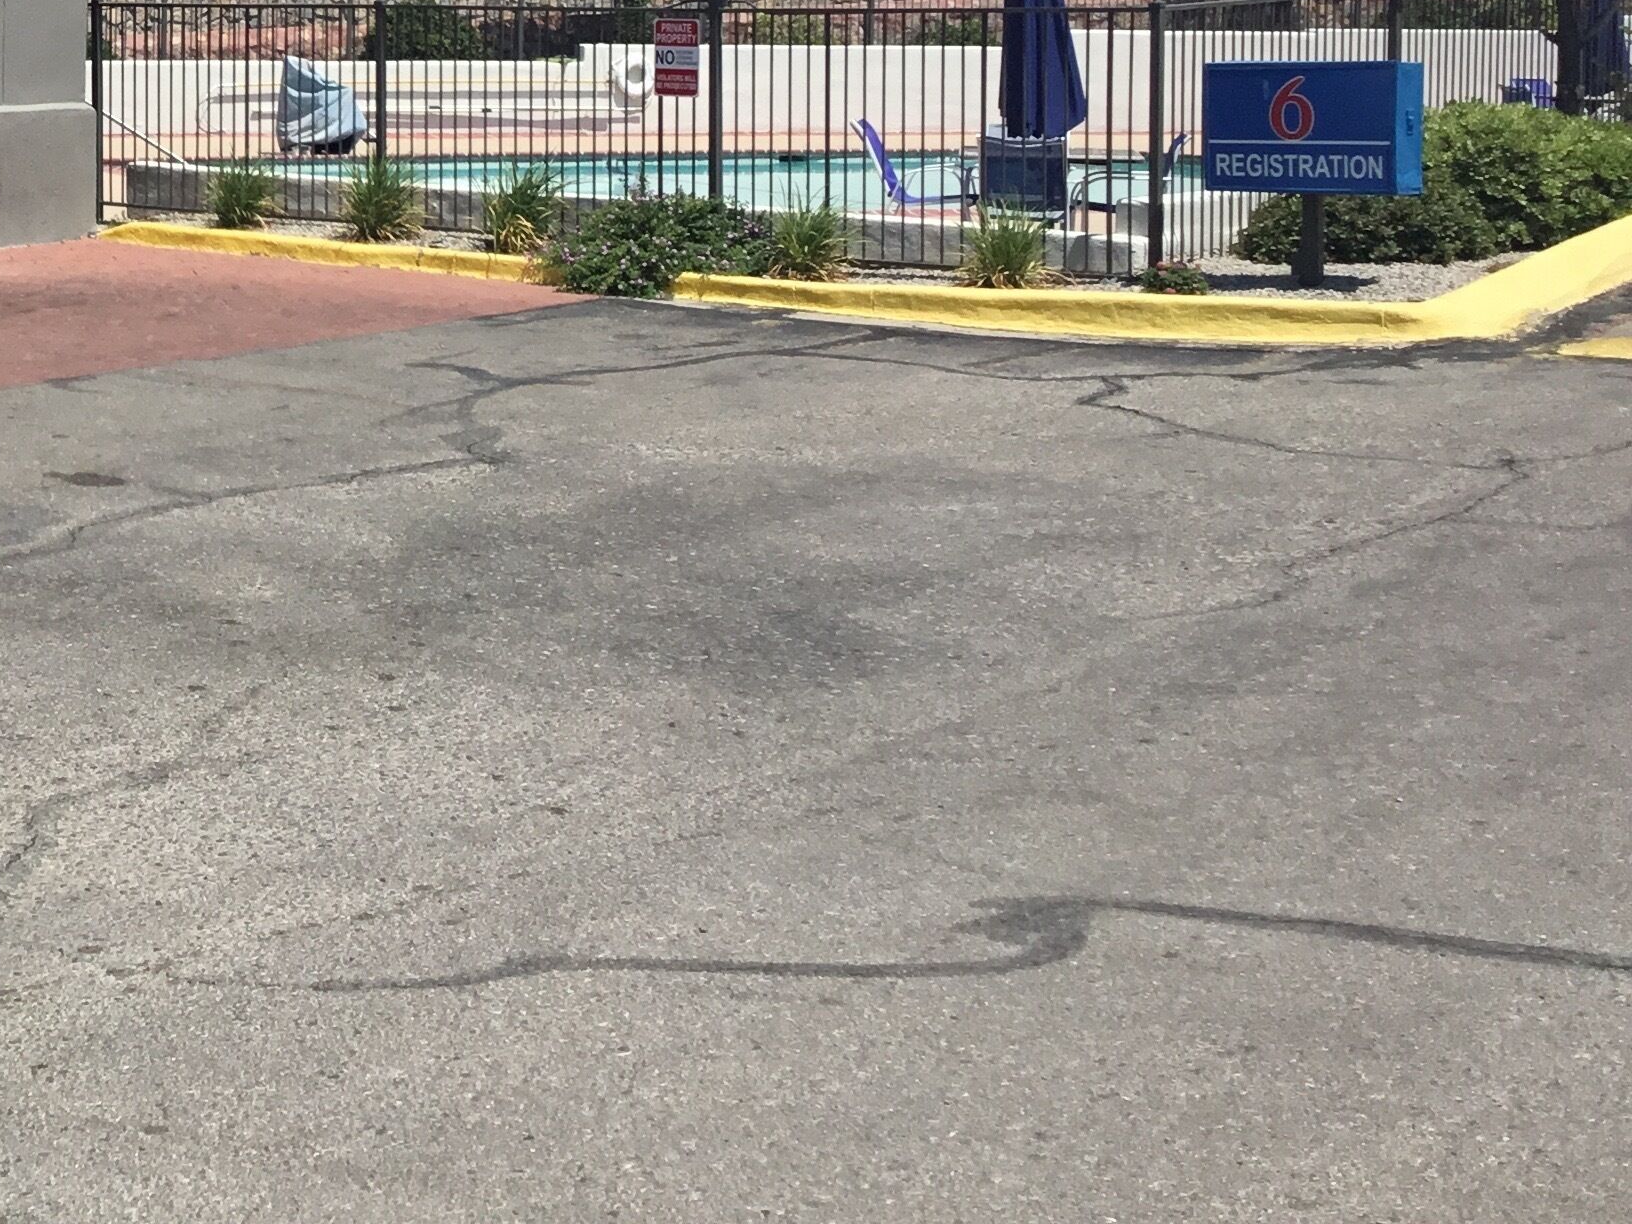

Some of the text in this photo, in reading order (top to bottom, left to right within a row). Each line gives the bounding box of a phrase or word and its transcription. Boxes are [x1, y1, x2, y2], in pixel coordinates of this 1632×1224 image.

[661, 23, 693, 34] PRIVATE
[656, 33, 696, 44] PROPERTY
[656, 49, 675, 65] NO
[1269, 75, 1315, 142] 6
[1215, 153, 1384, 179] REGISTRATION
